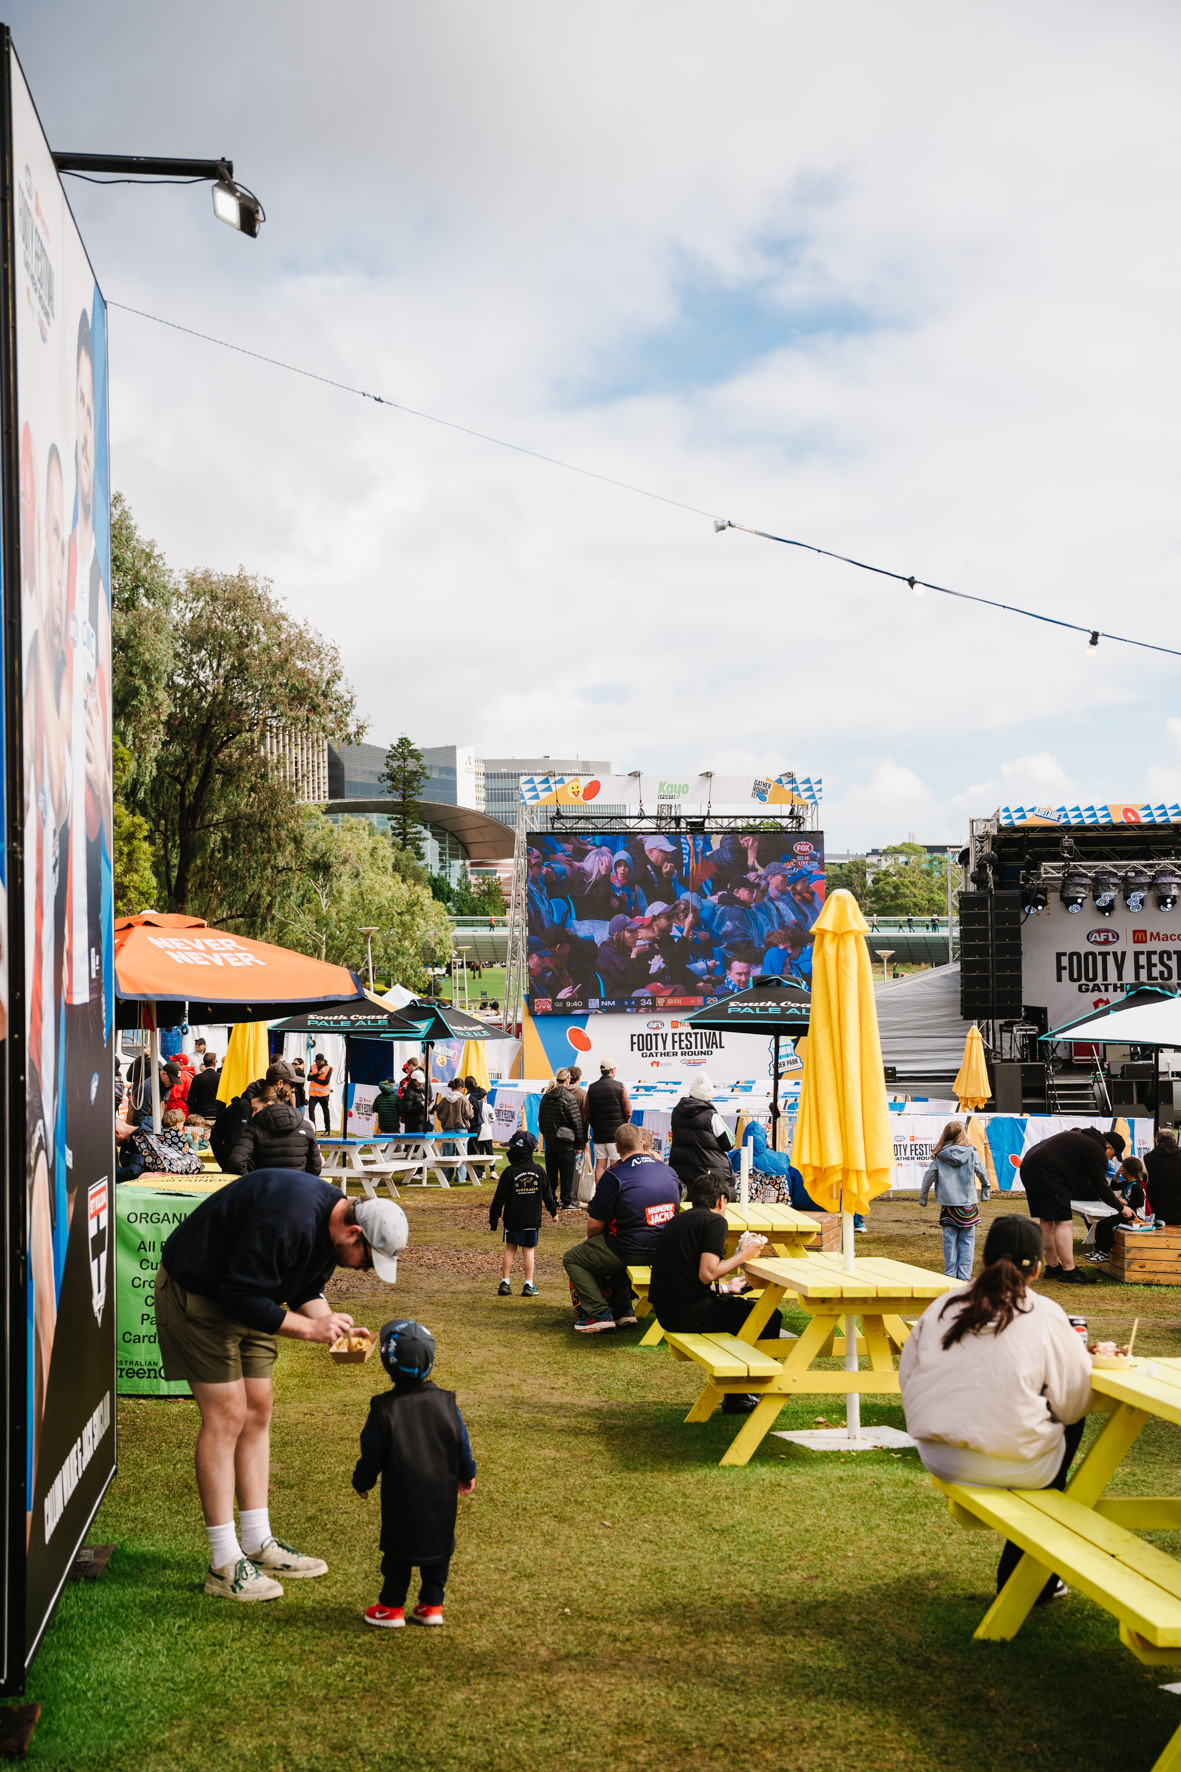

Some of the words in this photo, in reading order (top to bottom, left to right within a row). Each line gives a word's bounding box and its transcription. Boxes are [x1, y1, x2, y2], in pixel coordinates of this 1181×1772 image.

[658, 781, 689, 799] Kayo
[796, 844, 810, 852] FOX
[146, 936, 249, 951] NEVER
[1089, 932, 1117, 942] AFL
[164, 950, 267, 967] NEVER
[1056, 951, 1127, 983] FOOTY
[1133, 950, 1181, 981] FEST
[1078, 983, 1127, 993] GATH
[640, 998, 653, 1006] 34
[354, 1019, 389, 1027] ALE
[630, 1033, 668, 1052] FOOTY
[671, 1031, 725, 1050] FESTIVAL
[893, 1143, 908, 1156] OTY
[648, 1204, 673, 1215] HUNGRY
[137, 1240, 156, 1252] All
[139, 1258, 160, 1270] Cu
[131, 1276, 156, 1289] Cro
[140, 1313, 157, 1326] Pa
[122, 1331, 159, 1344] Card
[116, 1365, 165, 1379] reen
